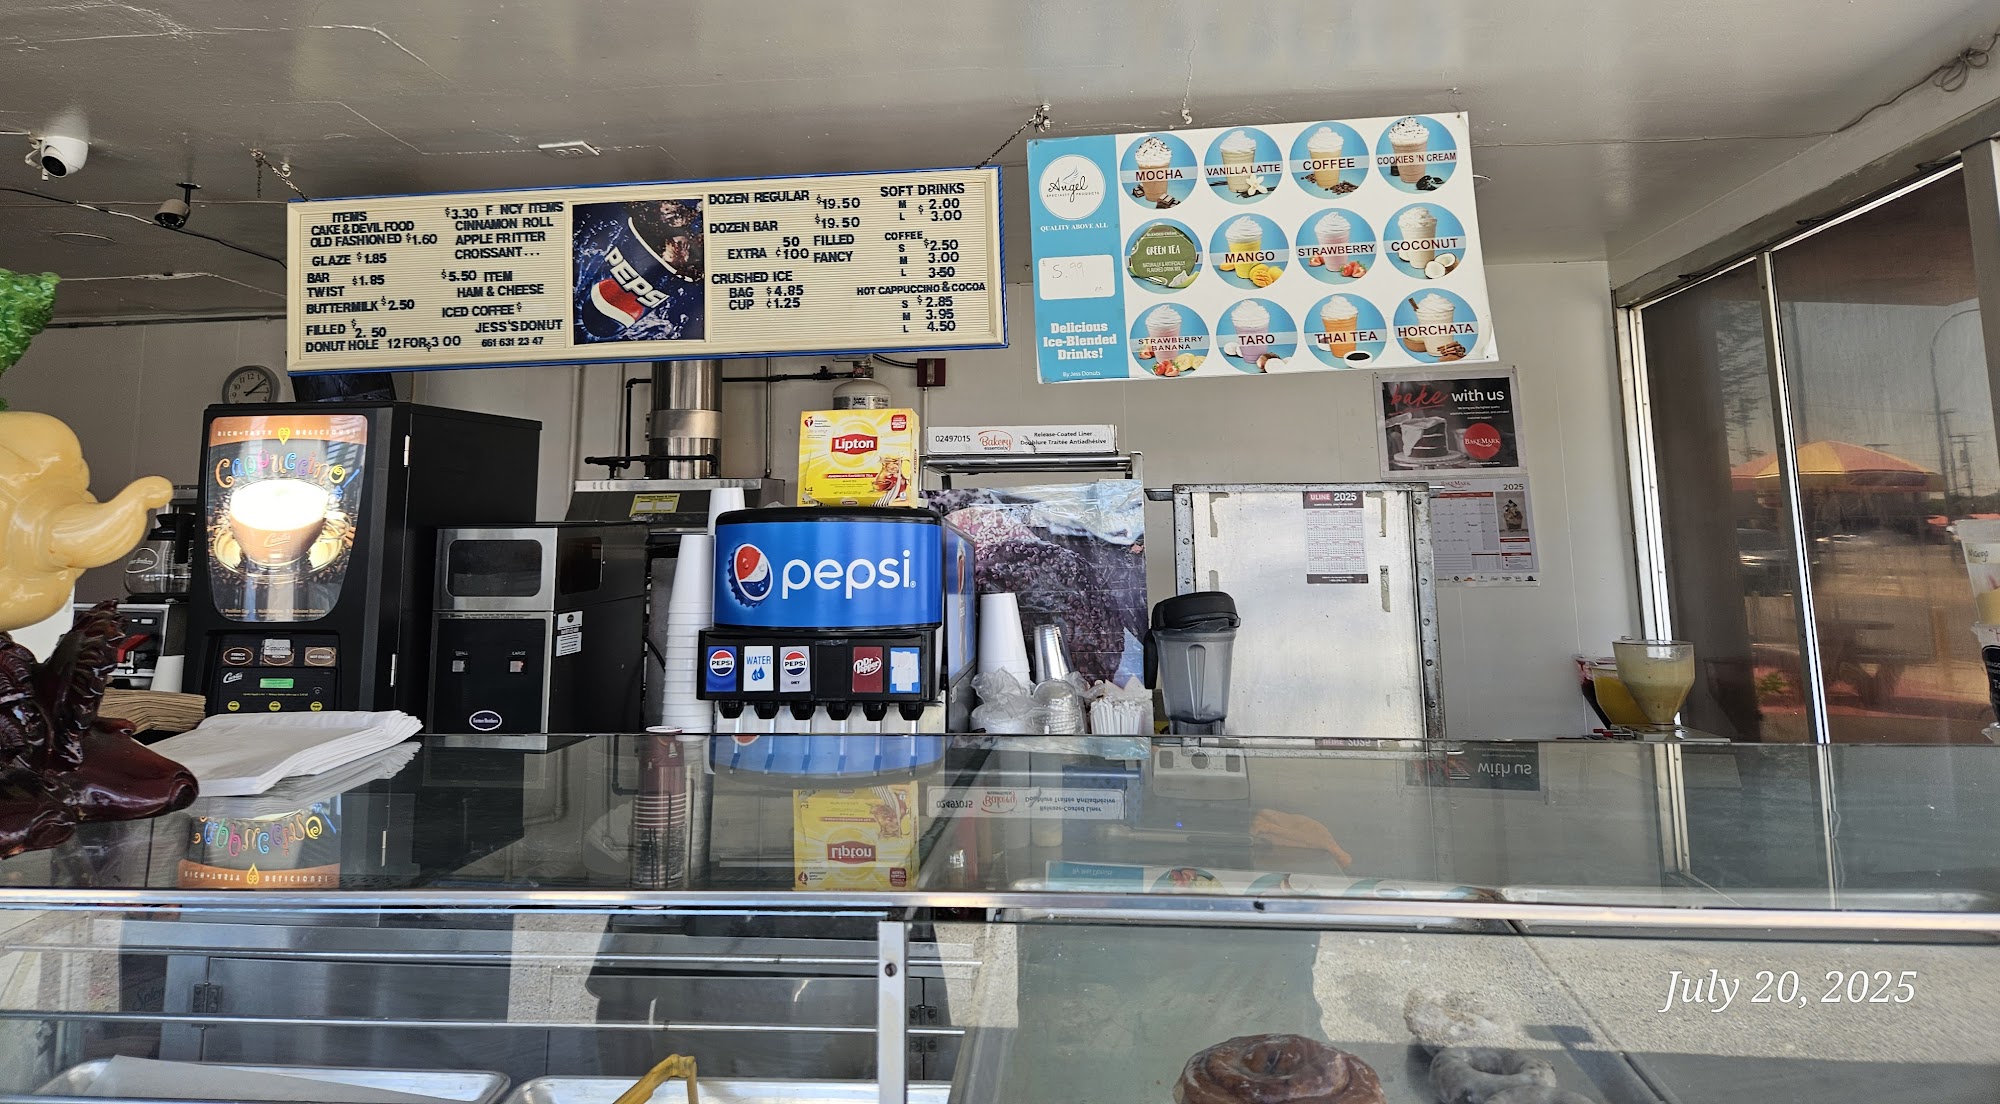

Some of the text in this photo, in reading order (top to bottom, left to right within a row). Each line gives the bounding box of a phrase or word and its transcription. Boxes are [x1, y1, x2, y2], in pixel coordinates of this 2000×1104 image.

[1302, 158, 1355, 170] COFFEE
[1376, 152, 1457, 165] COOKIES 'N CREAM
[1135, 168, 1184, 181] MOCHA
[1206, 163, 1281, 175] VANILLA LATTE
[880, 182, 965, 197] SOFT DRINKS
[1048, 175, 1089, 203] Angel
[708, 192, 750, 205] DOZEN
[753, 190, 810, 202] REGULAR
[898, 199, 907, 208] M
[529, 201, 564, 213] ITEMS
[332, 211, 367, 222] ITEMS
[899, 212, 905, 220] L
[311, 220, 415, 235] CAKE & DEVIL FOOD
[455, 216, 554, 230] CINNAMON ROLL
[709, 221, 750, 234] DOZEN
[753, 220, 779, 231] BAR
[1040, 224, 1070, 232] QUALITY
[1071, 222, 1094, 230] ABOVE
[455, 230, 546, 245] APPLE FRITTER
[782, 233, 855, 247] 50 FILLED
[884, 230, 923, 241] COFFEE
[310, 237, 332, 247] OLD
[898, 243, 905, 252] S
[1390, 238, 1459, 251] COCONUT
[727, 247, 767, 259] EXTRA
[813, 250, 854, 262] FANCY
[1146, 244, 1181, 255] GREEN TEA
[1297, 243, 1376, 257] STRAWBERRY
[312, 254, 351, 265] GLAZE
[899, 251, 960, 264] M 3.00
[1224, 251, 1276, 263] MANGO
[307, 272, 330, 283] BAR
[484, 270, 513, 281] ITEM
[711, 270, 793, 284] CRUSHED ICE
[900, 268, 907, 276] L
[306, 286, 345, 297] TWIST
[457, 283, 545, 297] HAM & CHEESE
[729, 286, 754, 298] BAG
[857, 281, 986, 296] HOT CAPPUCCINO & COCOA
[306, 300, 379, 314] BUTTERMILK
[728, 299, 755, 310] CUP
[901, 299, 909, 308] S
[442, 304, 515, 317] ICED COFFEE
[902, 308, 954, 320] M 3.95
[306, 323, 346, 335] FILLED
[520, 319, 564, 331] DONUT
[903, 320, 956, 332] L 4.50
[1050, 321, 1109, 333] Delicious
[1397, 322, 1475, 339] HORCHATA
[481, 336, 544, 347] 661 631 23 47
[1042, 333, 1118, 347] Ice-Blended
[1138, 335, 1204, 346] STRAWBERRY
[1238, 333, 1276, 346] TARO
[1314, 330, 1379, 344] THAI TEA
[305, 340, 346, 352] DONUT
[348, 338, 379, 350] HOLE
[387, 338, 401, 348] 12
[403, 337, 427, 347] FOR
[1151, 343, 1192, 352] BANANA
[1057, 347, 1104, 360] Drinks!
[1391, 384, 1505, 407] bake with us
[834, 437, 875, 451] Lipton
[934, 434, 971, 443] 02497015
[979, 435, 1013, 452] Bakery
[1020, 438, 1047, 446] Doublure
[1503, 483, 1525, 491] 2025
[1333, 492, 1358, 501] 2025
[781, 549, 910, 600] pepsi
[746, 656, 772, 665] WATER
[862, 657, 874, 666] Dr
[854, 660, 882, 675] Pepper
